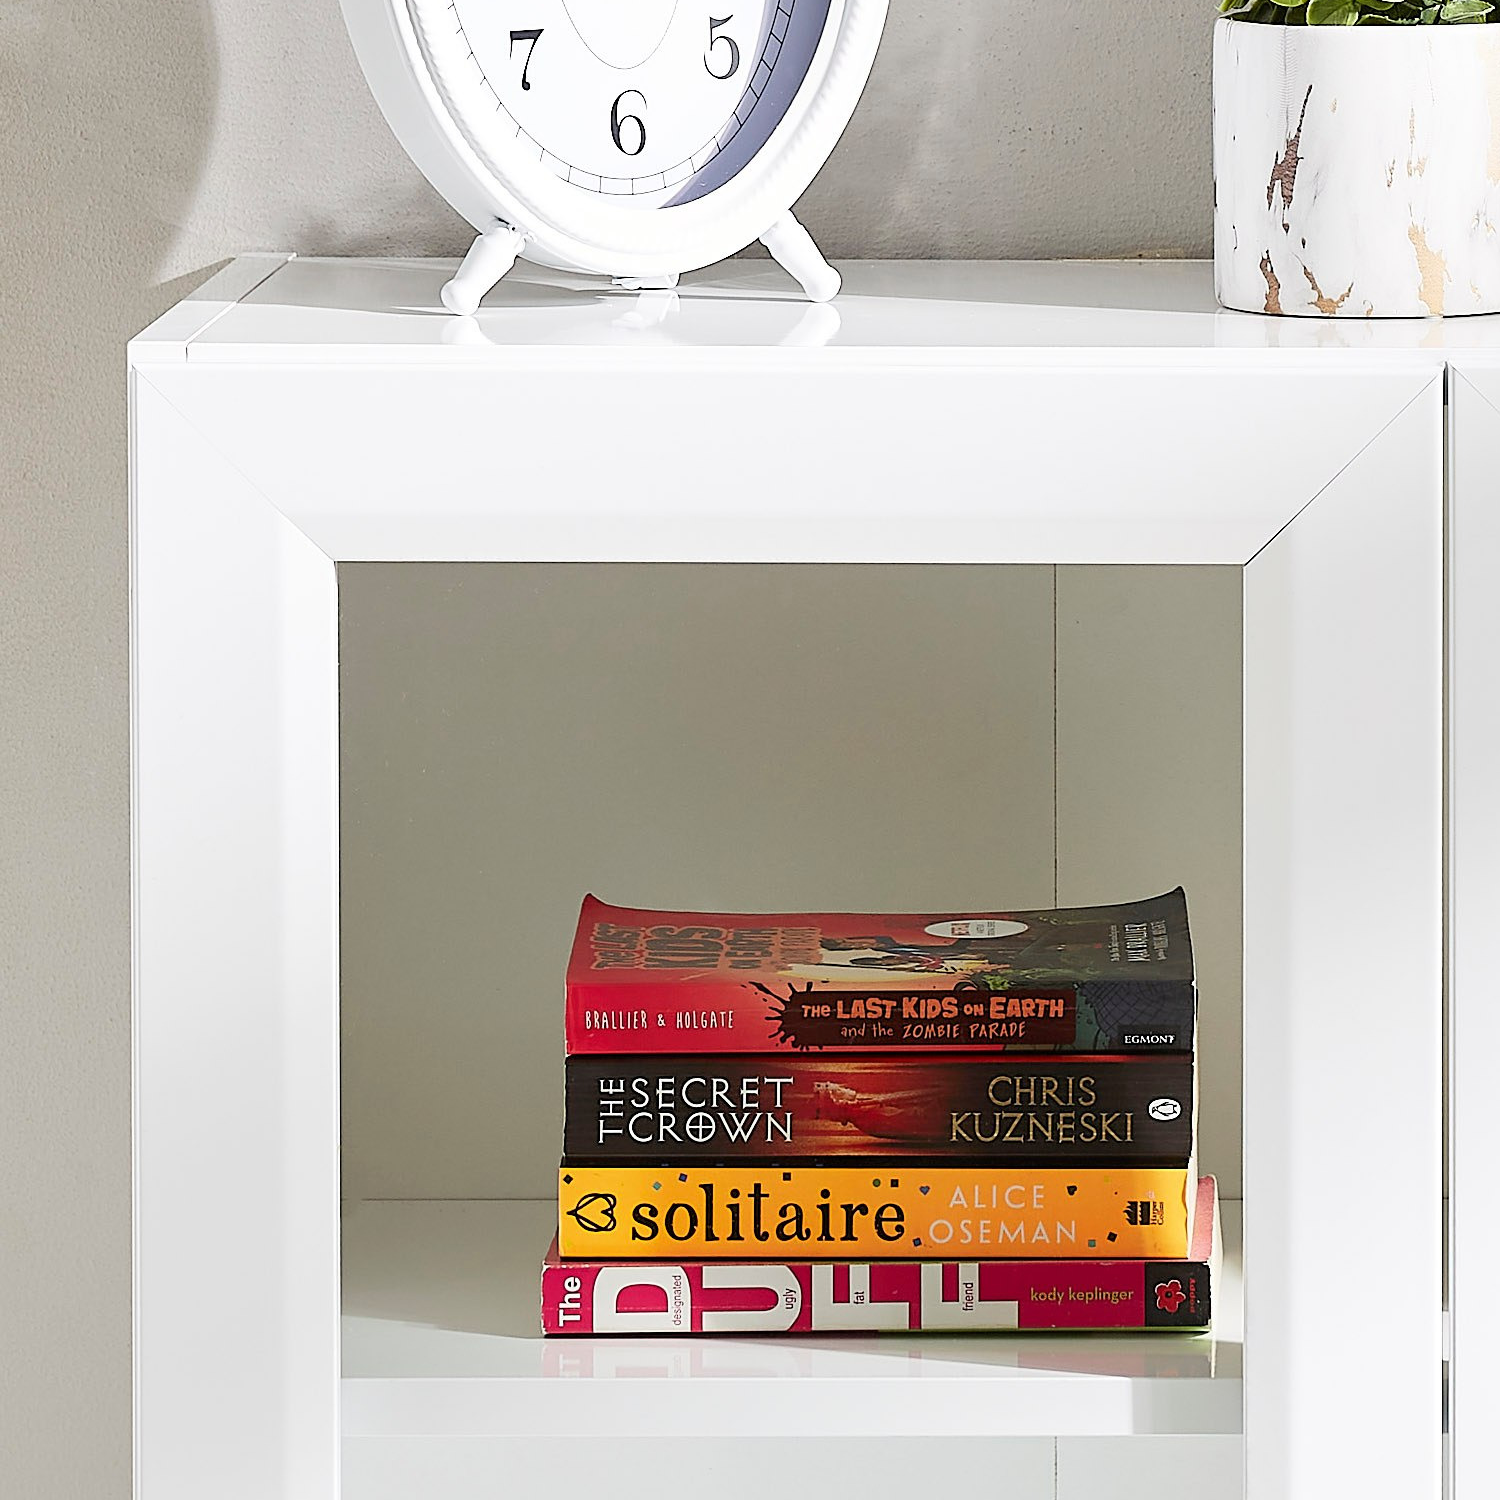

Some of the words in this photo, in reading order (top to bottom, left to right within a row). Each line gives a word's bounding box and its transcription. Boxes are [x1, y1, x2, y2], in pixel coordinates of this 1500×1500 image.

[508, 28, 545, 91] 7
[703, 14, 740, 80] 5
[610, 89, 648, 156] 6
[642, 924, 727, 970] KIDS
[585, 1010, 648, 1030] BRALLIER
[657, 1012, 667, 1029] &
[676, 1010, 735, 1030] HOLGATE
[836, 997, 897, 1019] LAST
[902, 996, 958, 1019] KIDS
[963, 1003, 985, 1016] ON
[989, 996, 1065, 1019] EARTH
[840, 1022, 866, 1038] and
[872, 1022, 894, 1038] the
[902, 1023, 960, 1040] ZOMBIE
[970, 1021, 1027, 1039] PARADE
[1124, 1034, 1176, 1045] EGMONT
[630, 1076, 794, 1110] SECRET
[987, 1075, 1097, 1107] CHRIS
[597, 1078, 626, 1144] THE
[628, 1111, 793, 1143] CROWN
[949, 1110, 1135, 1143] KUZNESKI
[630, 1182, 906, 1242] solitaire
[949, 1184, 1045, 1209] ALICE
[928, 1218, 1076, 1245] OSEMAN
[557, 1275, 582, 1328] The
[671, 1274, 683, 1327] designated
[783, 1287, 797, 1310] ugly
[853, 1290, 866, 1305] fat
[962, 1282, 974, 1312] friend
[1030, 1286, 1064, 1306] kody
[1068, 1286, 1134, 1305] keplinger
